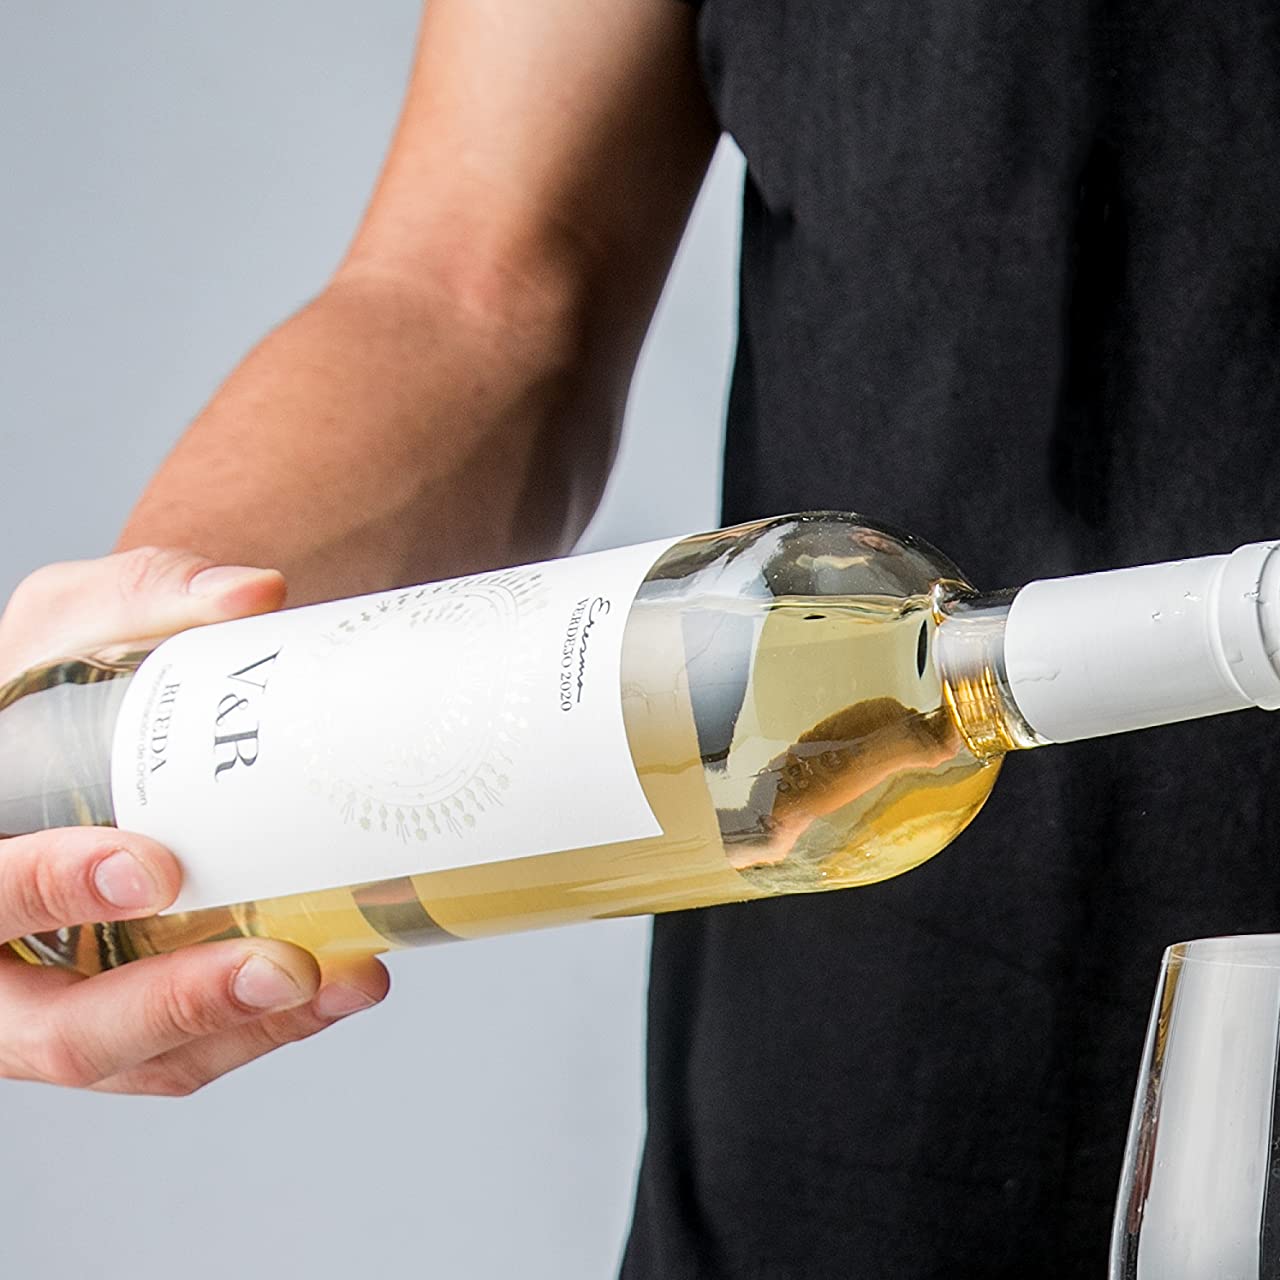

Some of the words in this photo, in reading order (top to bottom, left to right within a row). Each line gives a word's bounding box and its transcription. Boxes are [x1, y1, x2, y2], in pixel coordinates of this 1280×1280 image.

[561, 597, 590, 668] VERDEJO
[150, 680, 181, 773] RUEDA
[213, 646, 283, 783] V&R
[560, 672, 572, 712] 2020
[135, 761, 149, 807] Origen
